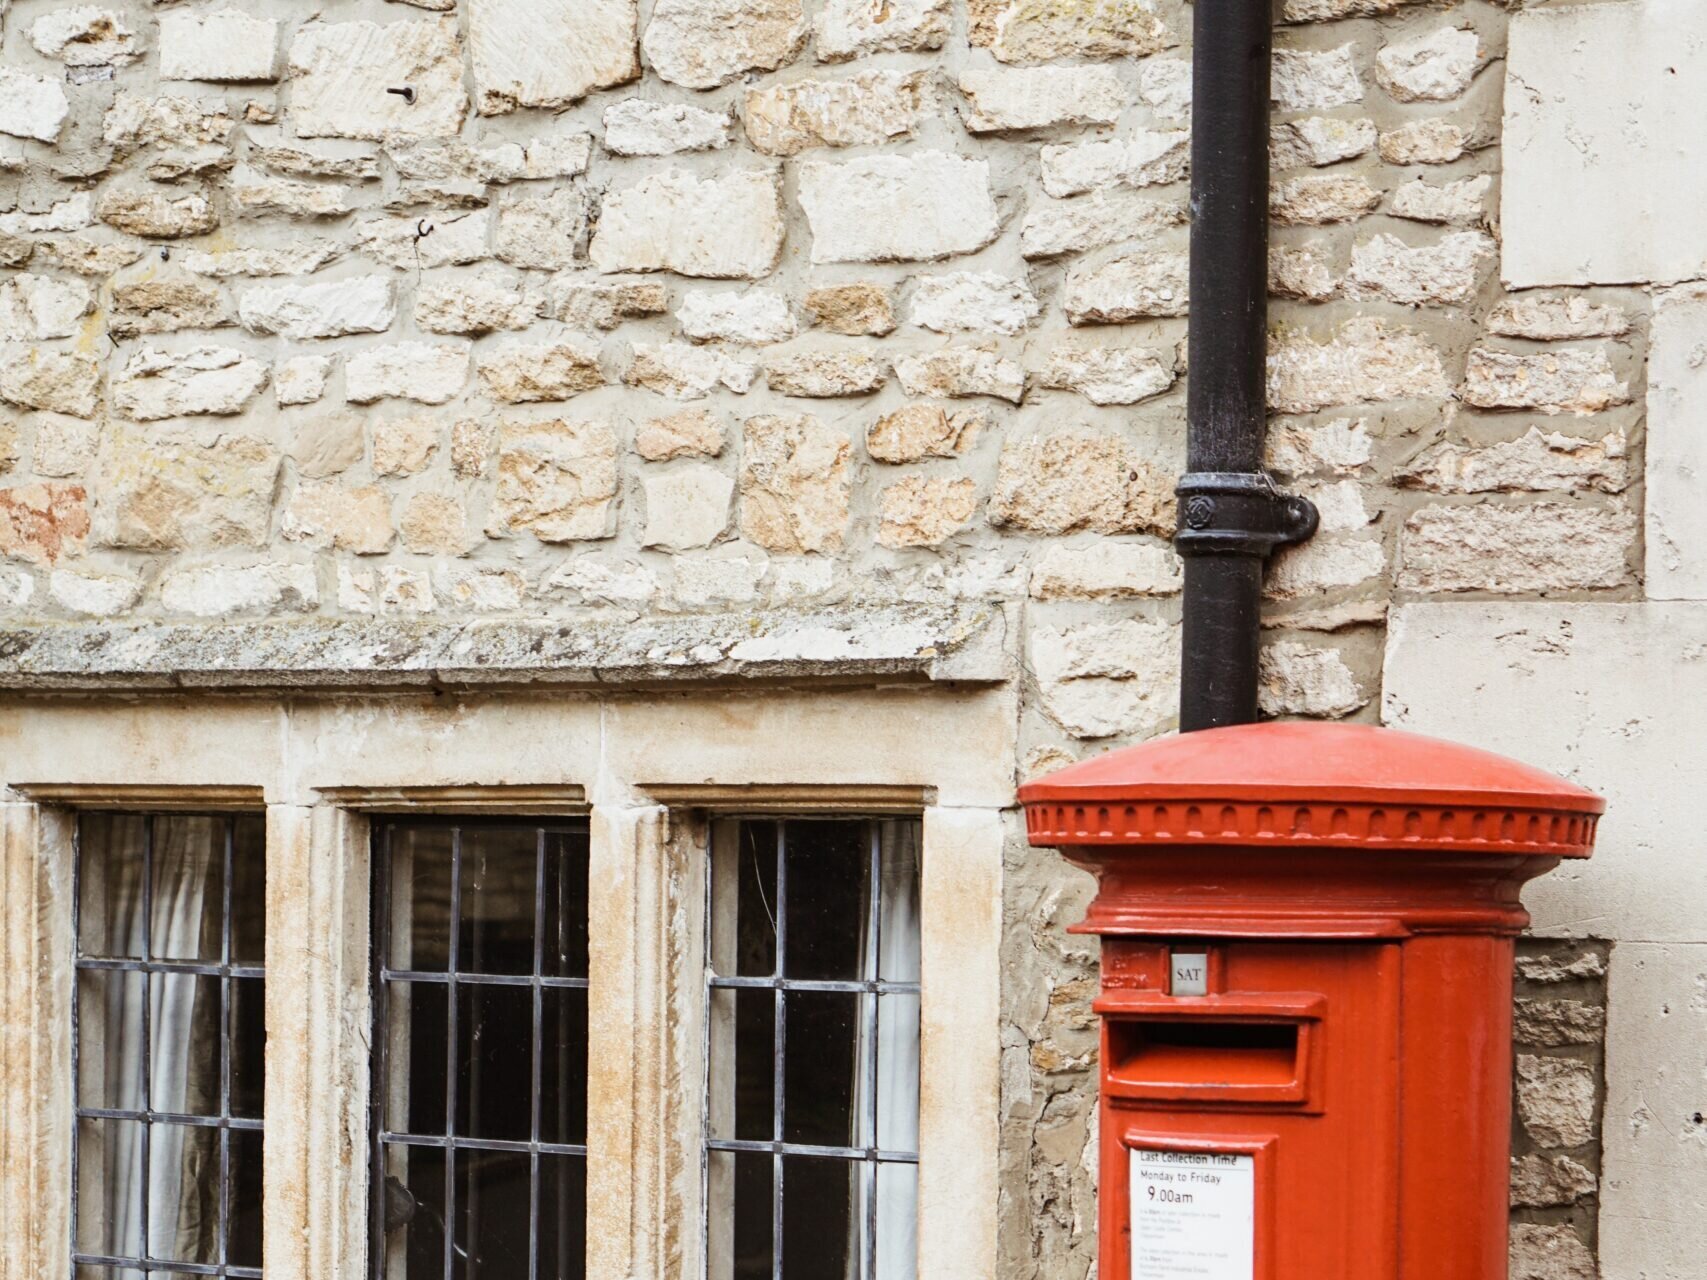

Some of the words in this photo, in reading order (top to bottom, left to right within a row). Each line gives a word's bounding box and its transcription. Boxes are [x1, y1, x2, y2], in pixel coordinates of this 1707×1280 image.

[1176, 967, 1202, 982] SAT
[1140, 1151, 1159, 1163] Last
[1161, 1152, 1208, 1165] Collection
[1211, 1154, 1238, 1167] Time
[1140, 1169, 1174, 1184] Monday
[1177, 1172, 1188, 1183] to
[1190, 1171, 1222, 1186] Friday
[1147, 1185, 1194, 1204] 9.00am
